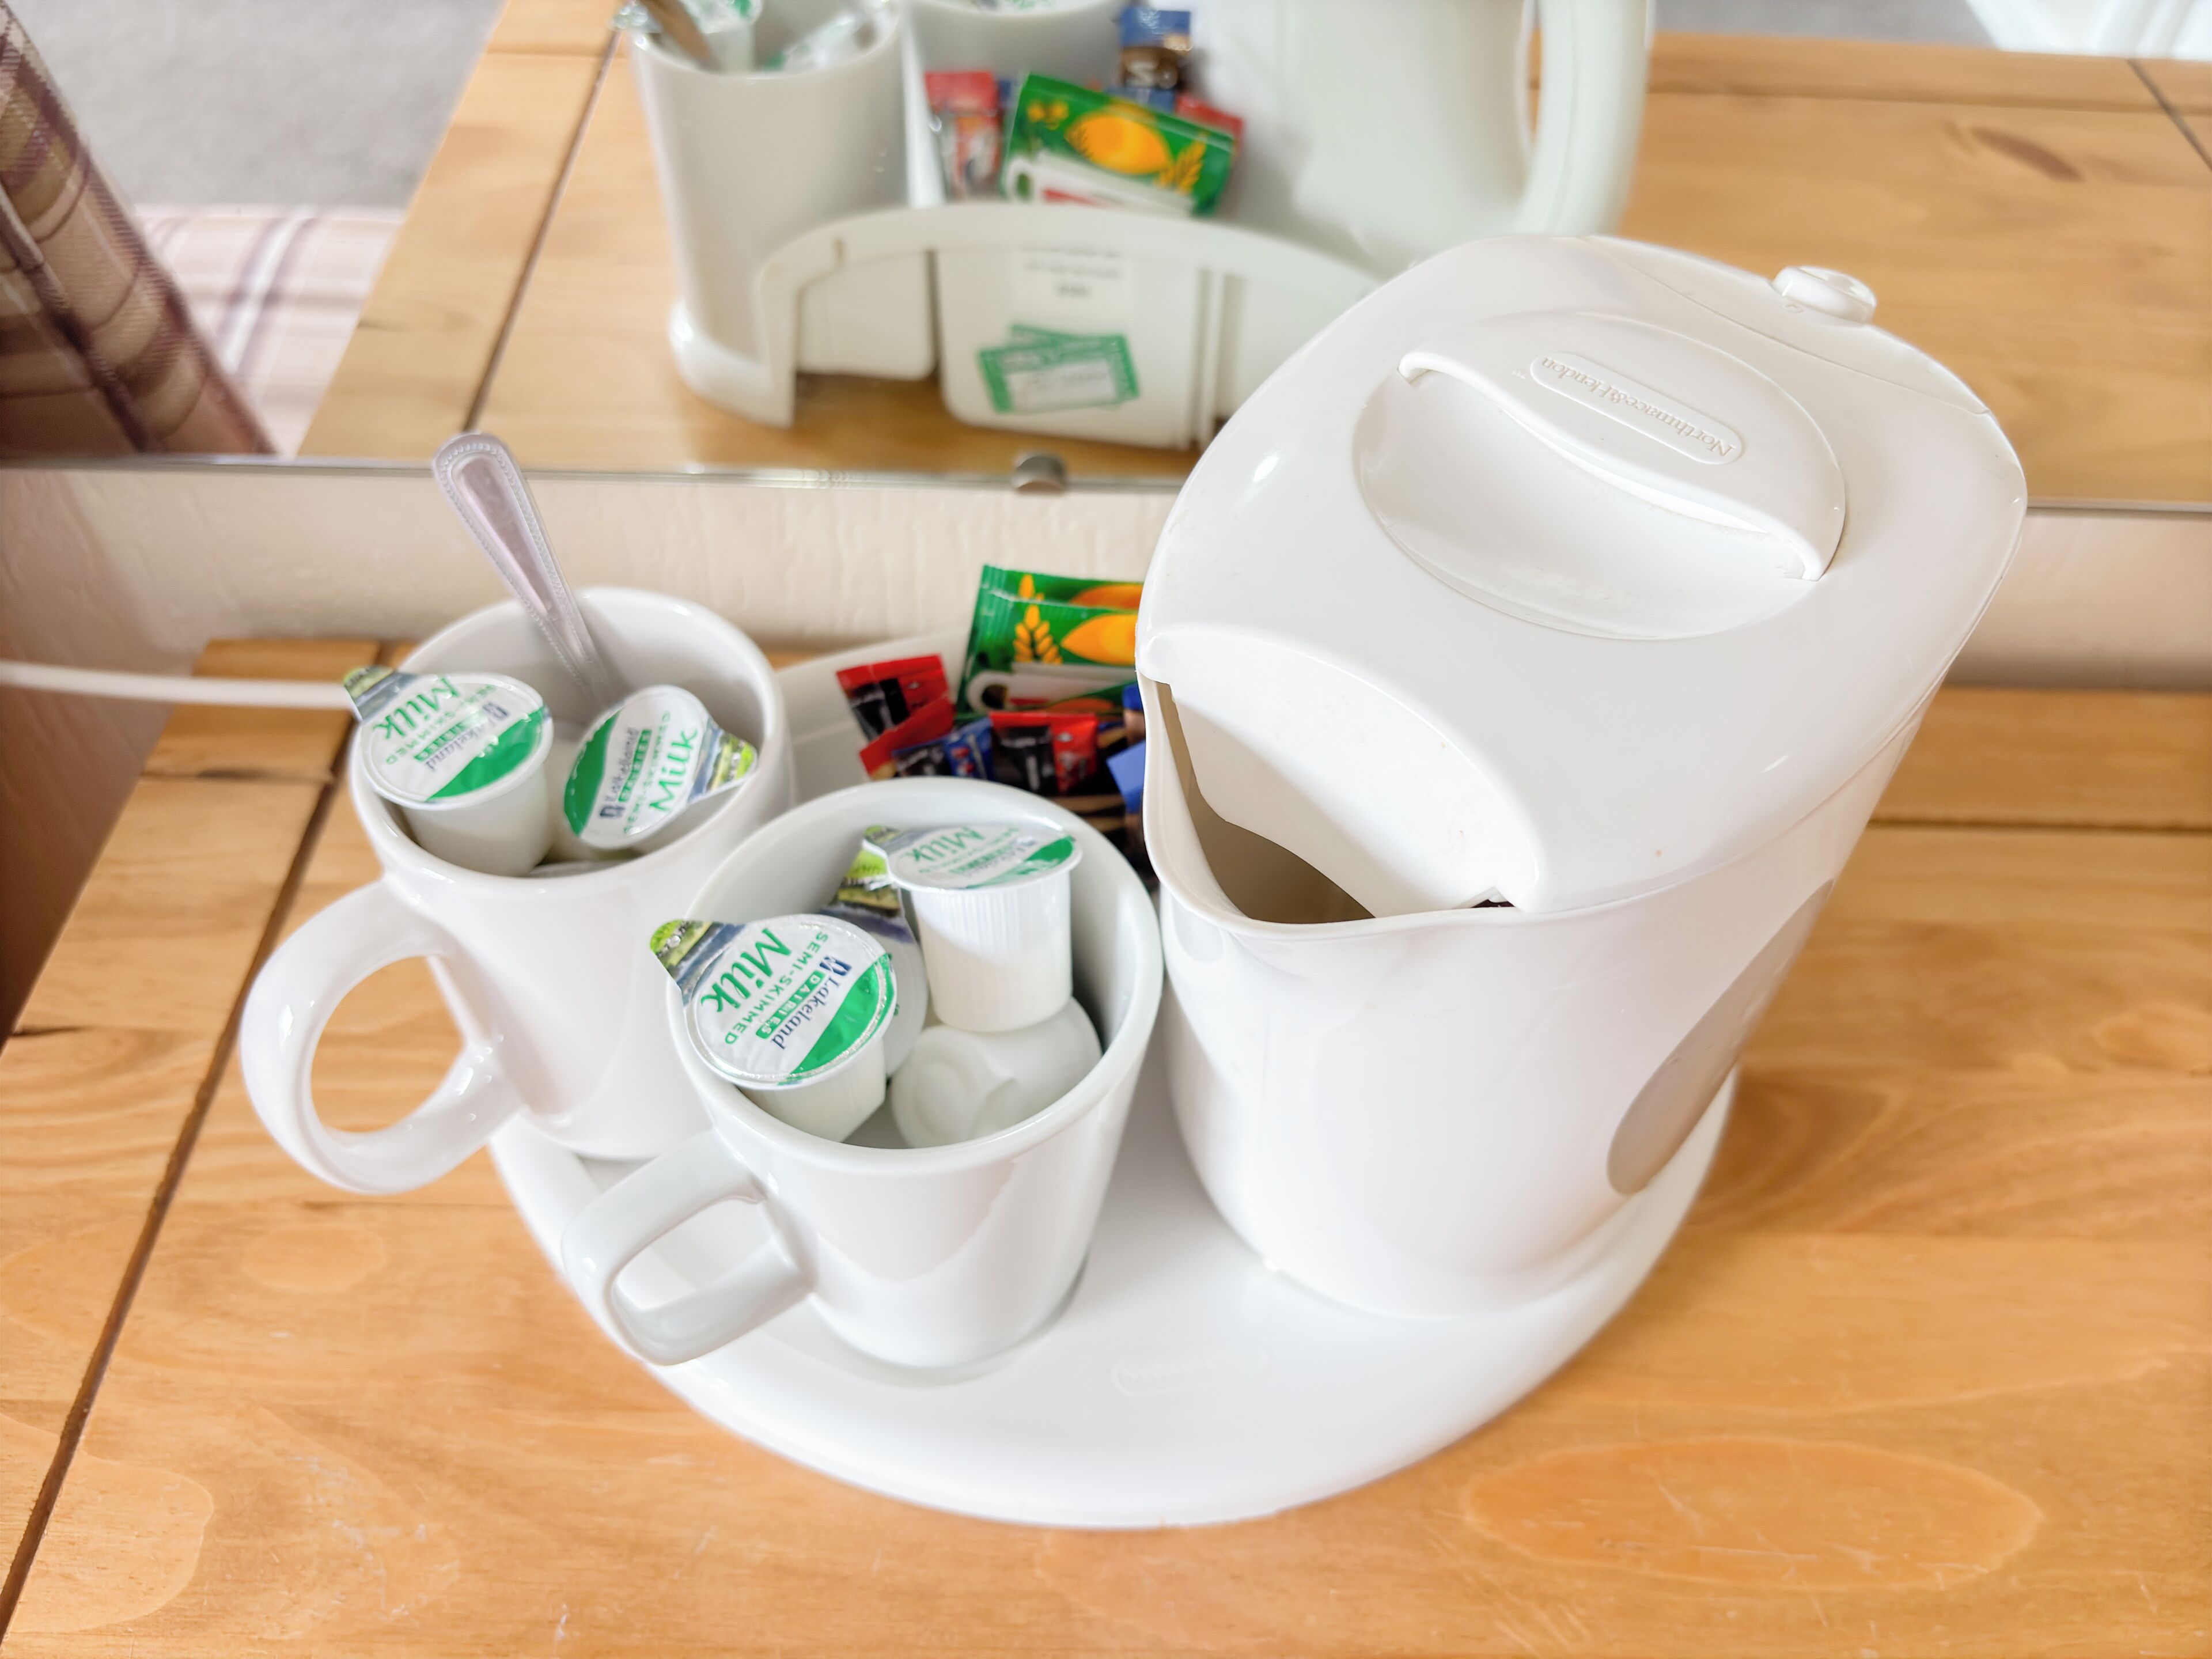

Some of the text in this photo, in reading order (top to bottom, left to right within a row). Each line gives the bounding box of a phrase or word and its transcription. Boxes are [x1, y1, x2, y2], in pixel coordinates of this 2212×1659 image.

[373, 676, 459, 740] Milk
[649, 728, 698, 812] Milk
[897, 825, 986, 862] Milk
[700, 927, 793, 1013] Milk
[724, 930, 830, 1045] SEMI-SKIMMED
[760, 971, 822, 1035] DAIRIES
[770, 978, 841, 1050] Lakeland
